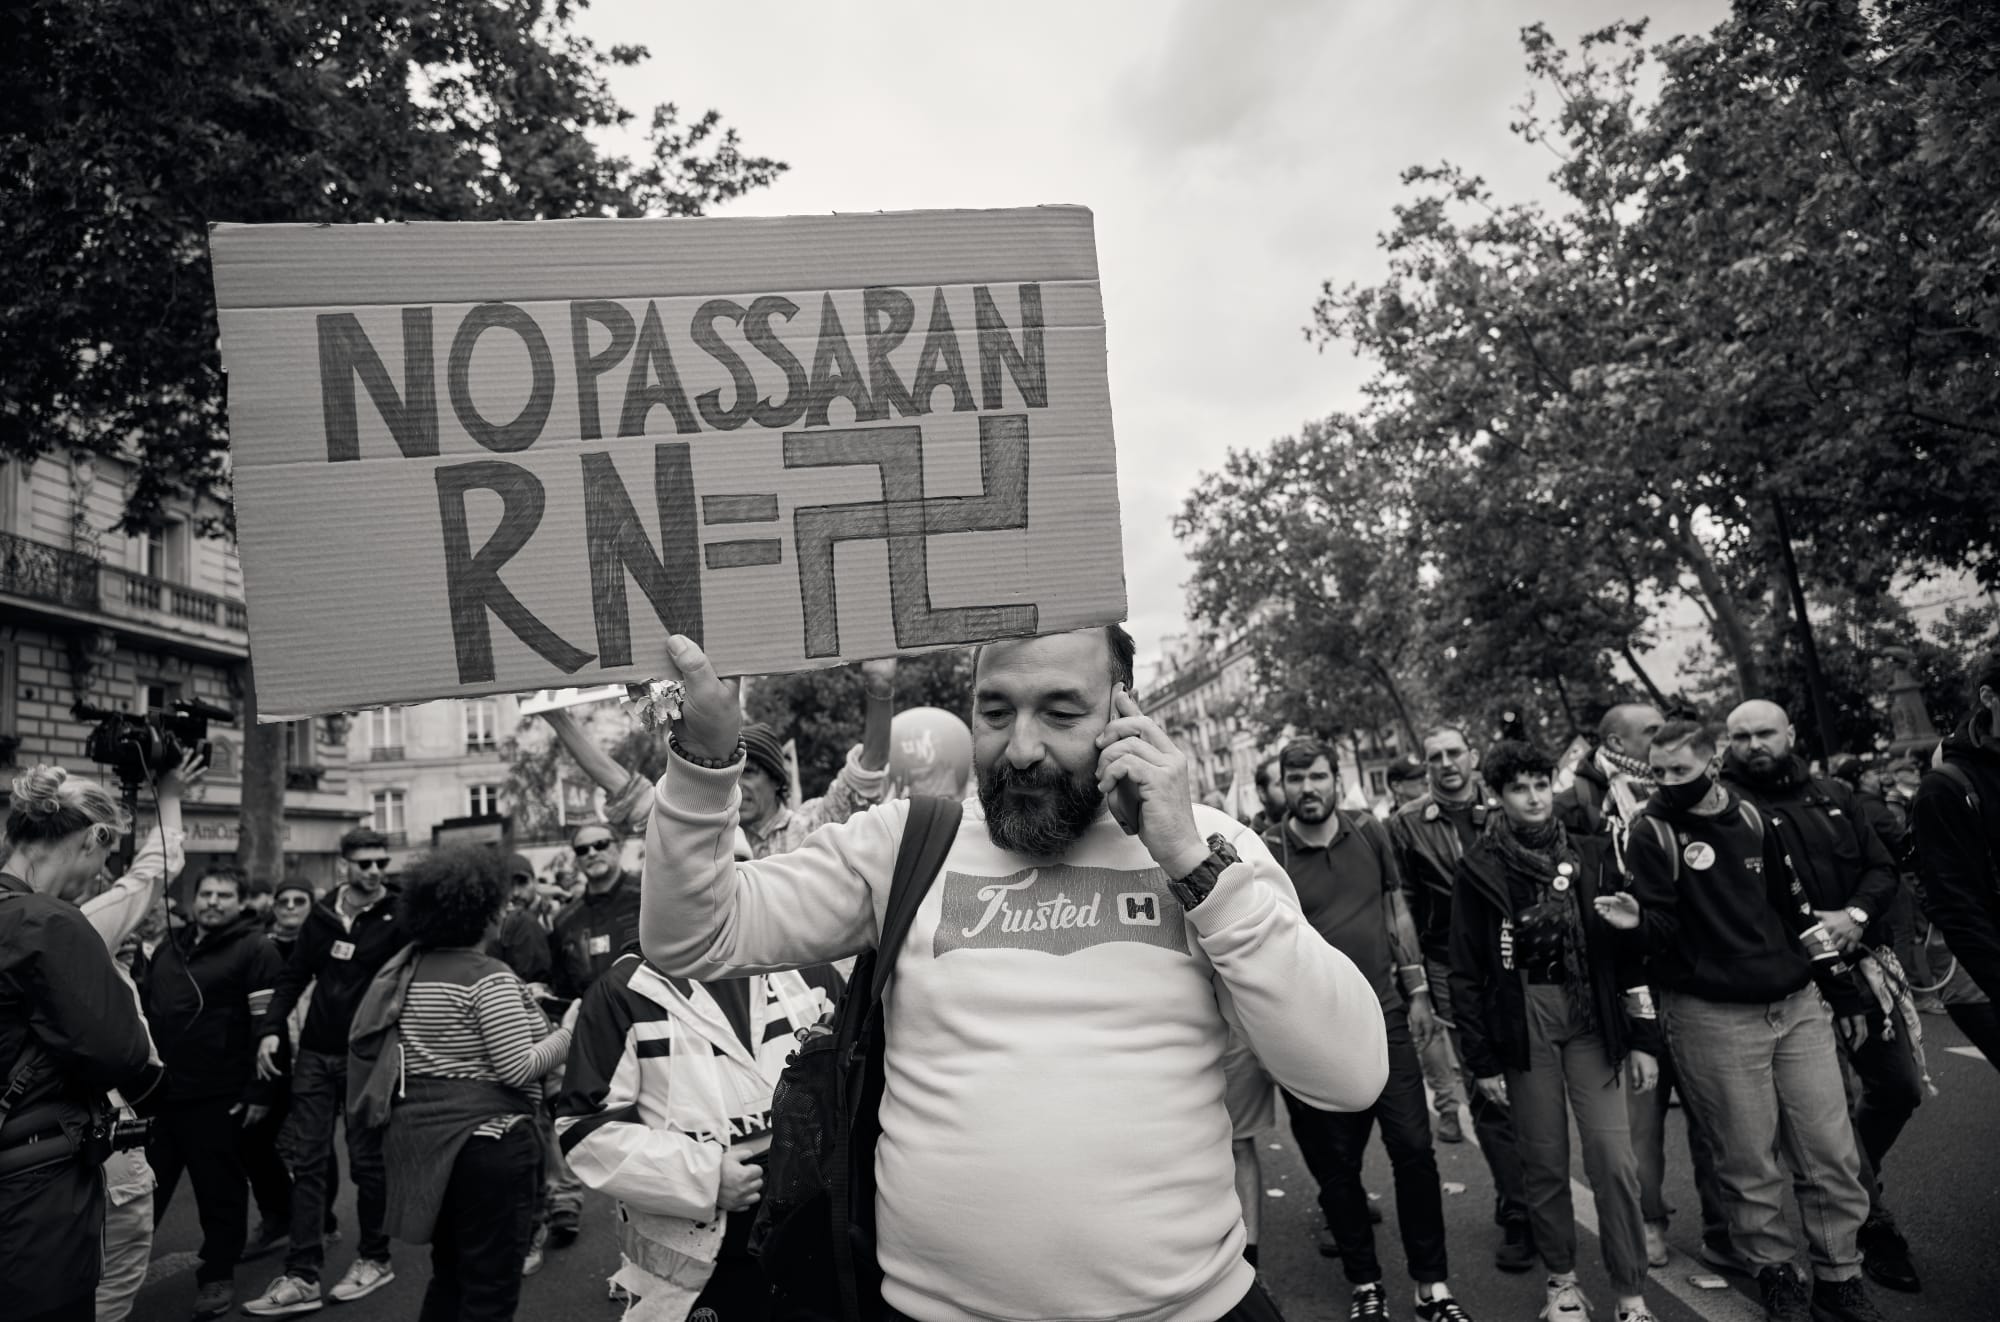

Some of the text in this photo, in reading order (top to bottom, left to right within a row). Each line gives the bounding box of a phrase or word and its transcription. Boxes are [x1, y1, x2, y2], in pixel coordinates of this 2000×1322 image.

[316, 284, 1049, 464] NO PASSARAN
[961, 868, 1102, 938] Trusted
